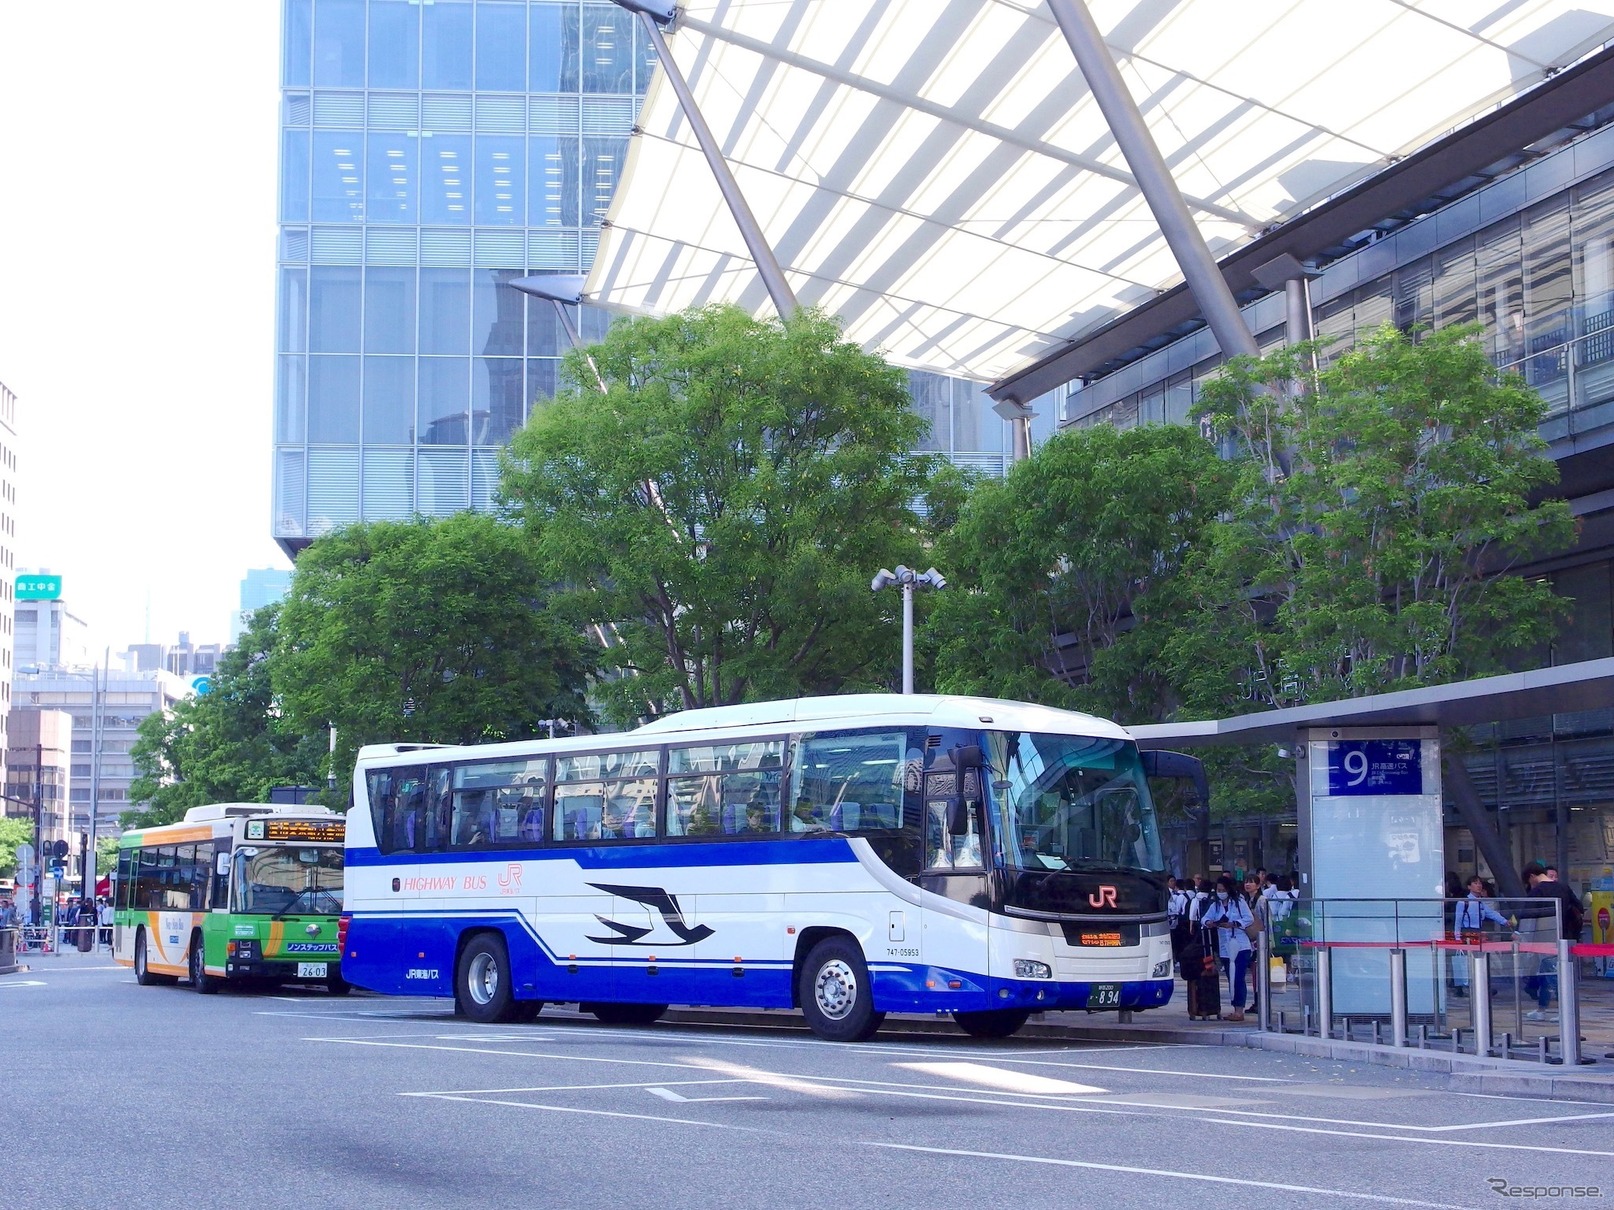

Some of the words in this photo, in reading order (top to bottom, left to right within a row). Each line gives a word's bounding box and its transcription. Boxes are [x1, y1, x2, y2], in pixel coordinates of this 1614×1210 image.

[1344, 750, 1369, 787] 9
[403, 876, 457, 891] HIGHWAY
[464, 875, 487, 890] BUS
[498, 863, 522, 887] JR
[1088, 885, 1118, 909] JR
[287, 943, 338, 951] ノンステップバス
[886, 948, 919, 957] 747-05953
[303, 967, 326, 976] 26-03
